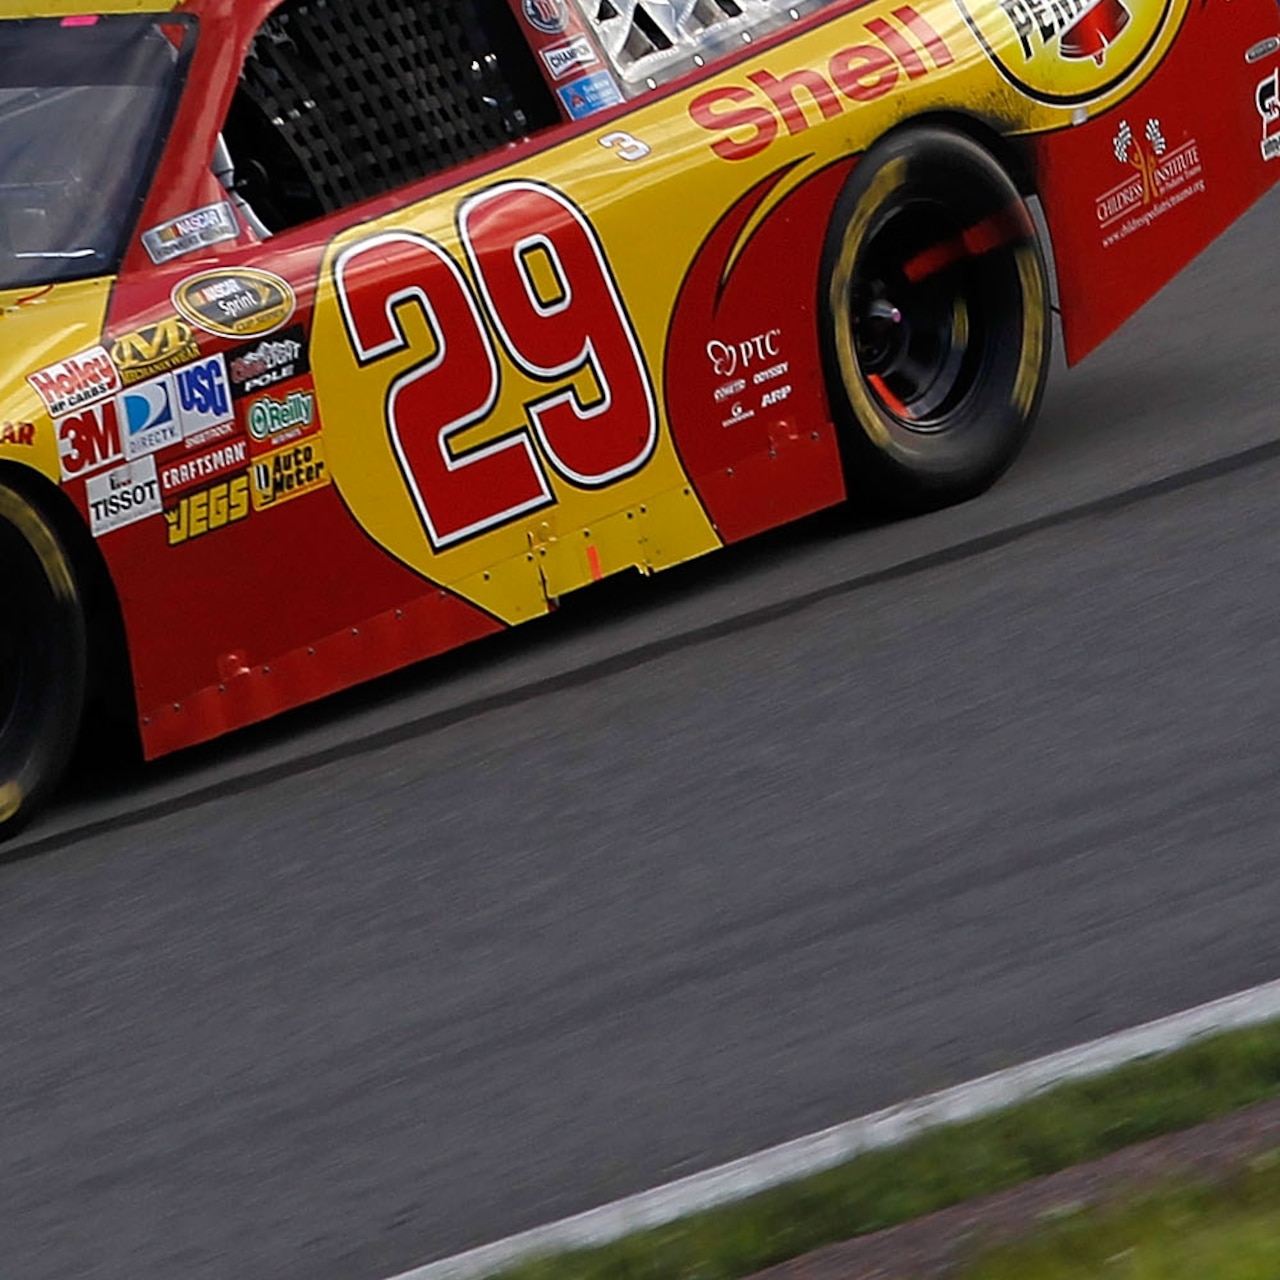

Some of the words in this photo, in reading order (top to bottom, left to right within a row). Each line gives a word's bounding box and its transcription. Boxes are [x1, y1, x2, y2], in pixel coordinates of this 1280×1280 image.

[688, 5, 955, 162] Shell
[218, 291, 258, 318] Sprint
[333, 181, 657, 554] 29
[739, 330, 779, 367] PTC
[32, 355, 117, 403] Holley
[50, 402, 65, 414] HP
[70, 383, 108, 406] CARBS
[176, 359, 230, 416] USG
[245, 364, 294, 392] POLE
[761, 385, 792, 408] ARP
[60, 400, 121, 473] 3M
[250, 393, 312, 438] O'Reilly
[130, 426, 176, 454] DIRECTV
[162, 442, 247, 489] CRAFTSMAN
[90, 481, 157, 521] TISSOT
[167, 476, 249, 545] JEGS
